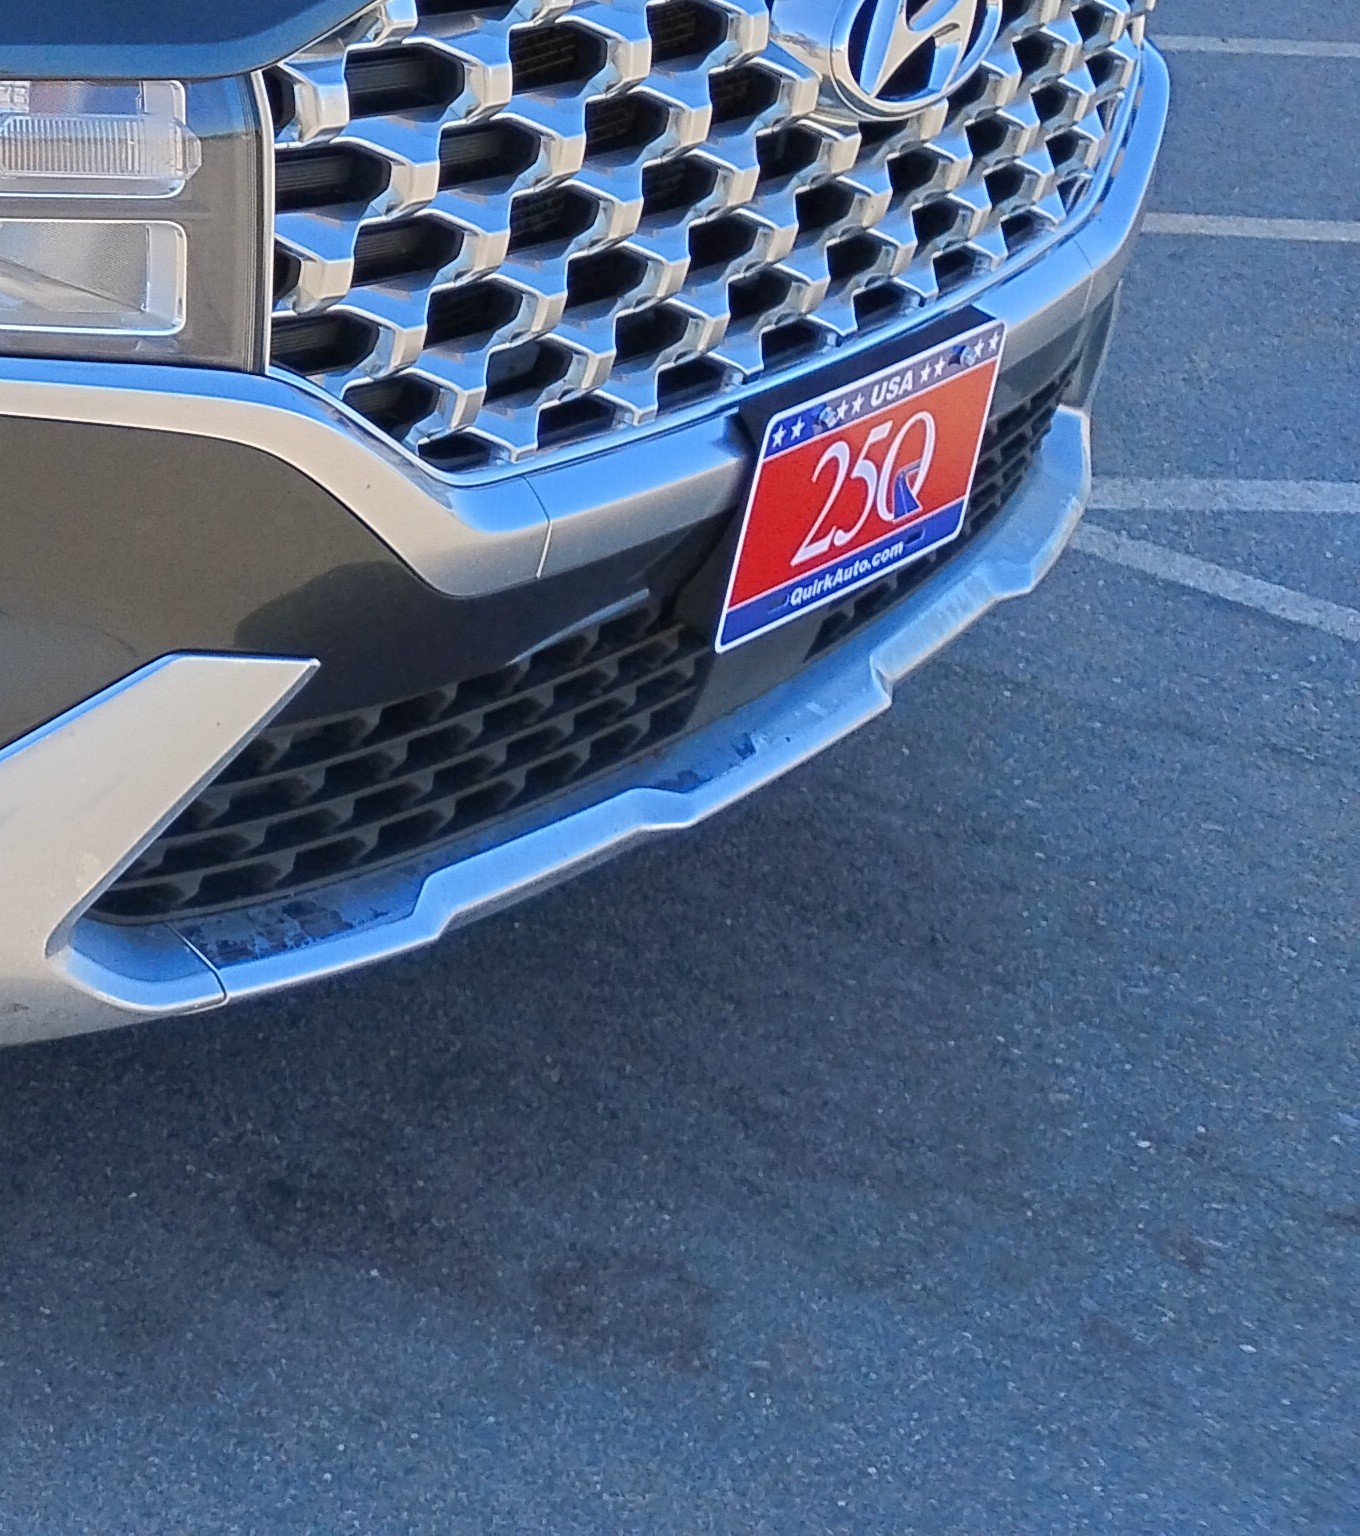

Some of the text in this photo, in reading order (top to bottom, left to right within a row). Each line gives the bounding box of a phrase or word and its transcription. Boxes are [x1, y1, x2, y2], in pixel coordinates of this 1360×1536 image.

[871, 369, 914, 407] USA
[791, 411, 936, 566] 250
[789, 540, 904, 605] QuirkAuto.com
